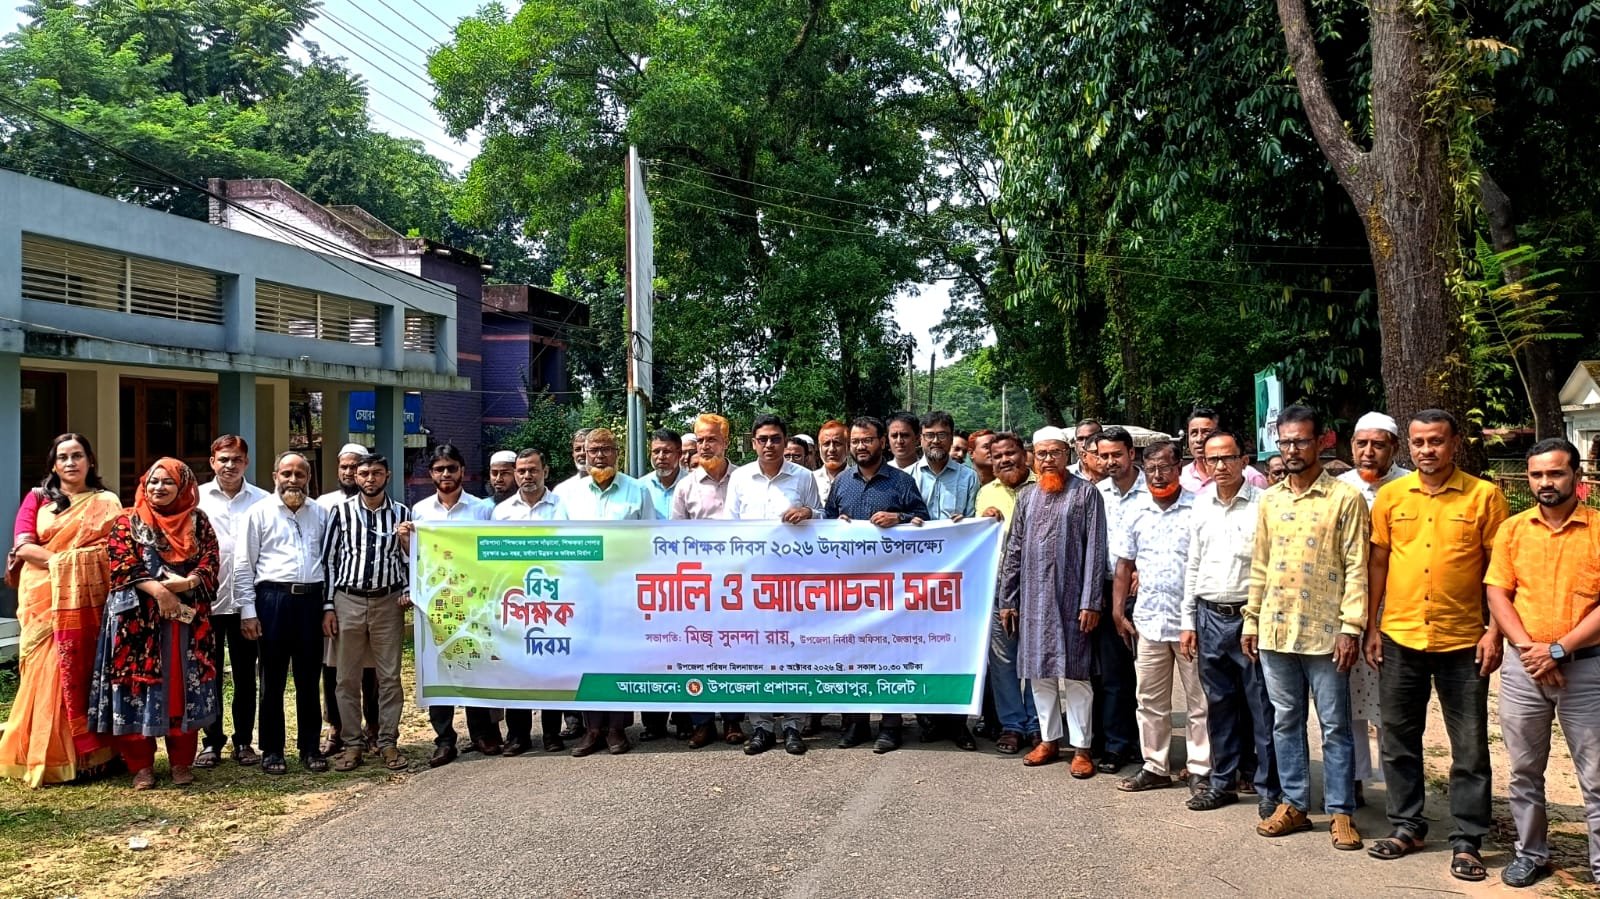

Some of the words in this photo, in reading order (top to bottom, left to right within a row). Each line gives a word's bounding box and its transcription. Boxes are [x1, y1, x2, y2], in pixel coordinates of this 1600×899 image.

[653, 536, 680, 555] বিশ্ব
[683, 536, 726, 555] শিক্ষক
[730, 536, 767, 556] দিবস
[770, 540, 814, 557] ২০২৬
[880, 536, 944, 555] উপলক্ষ্যে
[525, 569, 559, 600] বিশ্ব
[720, 574, 743, 612] ও
[751, 573, 895, 613] আলোচনা
[902, 572, 963, 612] সভা
[501, 589, 575, 627] শিক্ষক
[524, 627, 571, 656] দিবস
[645, 631, 682, 643] সভাপতি:
[718, 629, 759, 648] সুনন্দা
[764, 629, 796, 648] রায়,
[800, 634, 830, 645] উপজেলা
[833, 634, 855, 645] নির্বাহী
[858, 634, 890, 645] অফিসার,
[892, 633, 926, 646] জৈন্তাপুর,
[928, 632, 951, 643] সিলেট
[676, 662, 704, 671] উপজেলা
[902, 662, 923, 671] ঘটিকা
[616, 680, 681, 694] আয়োজনে:
[708, 680, 760, 694] উপজেলা
[764, 681, 812, 696] প্রশাসন,
[816, 679, 873, 698] জৈন্তাপুর,
[876, 679, 916, 695] সিলেট
